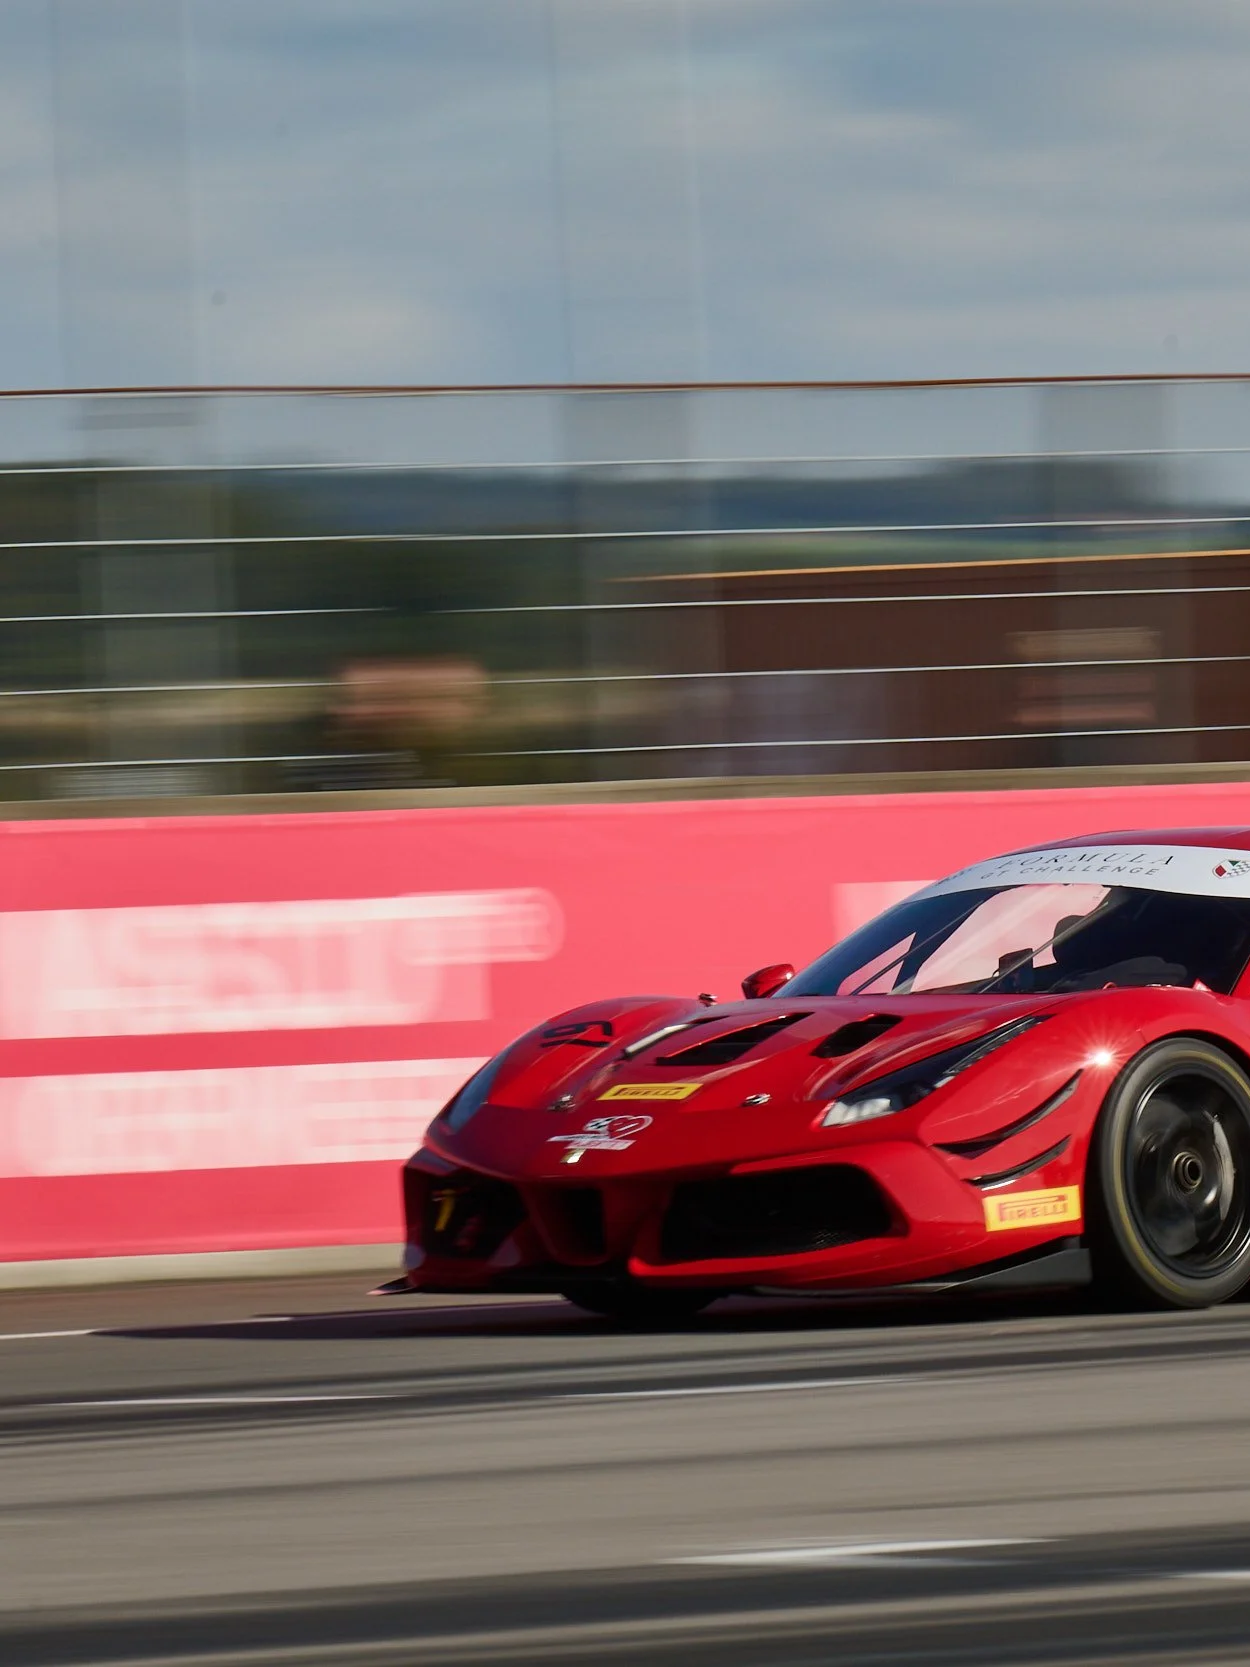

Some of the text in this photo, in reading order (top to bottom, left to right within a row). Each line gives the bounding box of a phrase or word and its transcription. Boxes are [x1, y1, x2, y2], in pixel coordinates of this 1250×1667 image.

[997, 852, 1175, 869] FORMULA
[980, 865, 1161, 880] GT CHALLENGE
[998, 1195, 1068, 1222] PIRELLI
